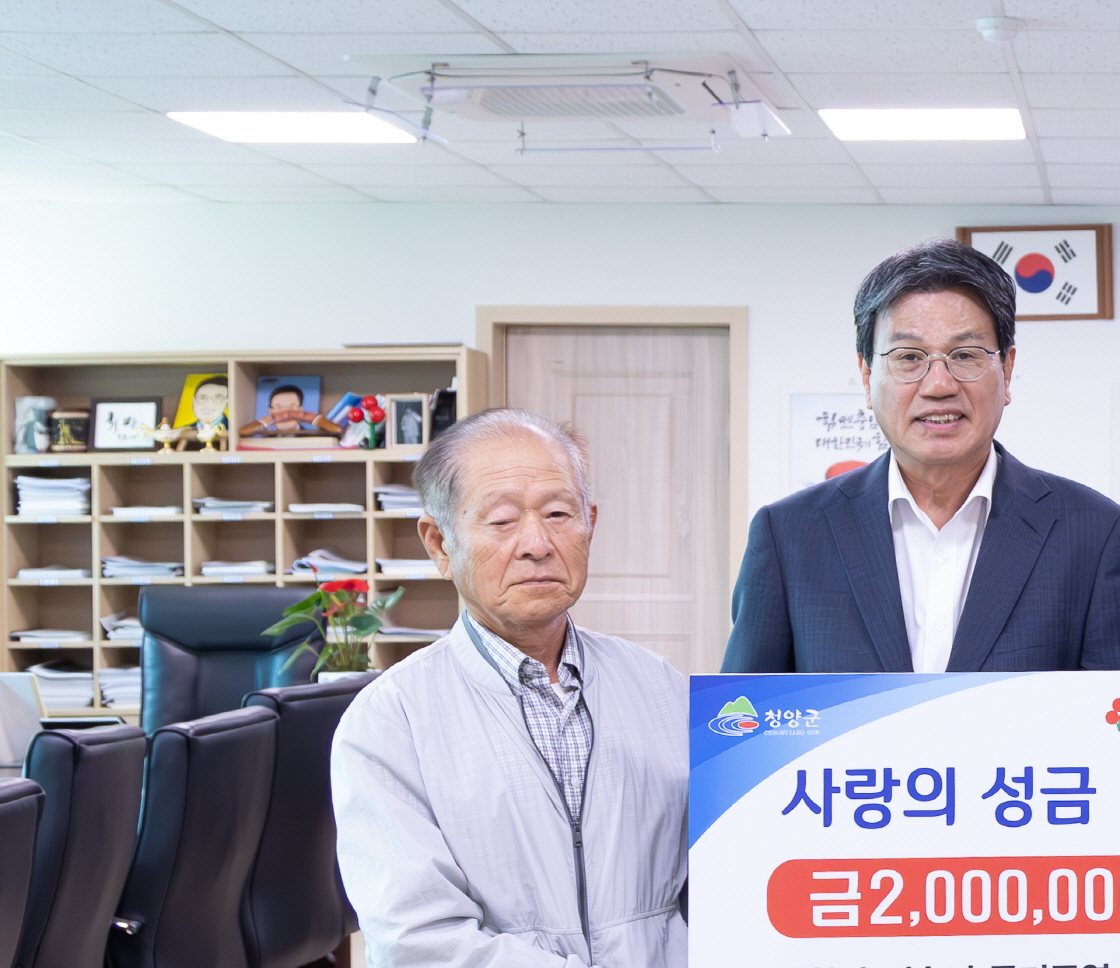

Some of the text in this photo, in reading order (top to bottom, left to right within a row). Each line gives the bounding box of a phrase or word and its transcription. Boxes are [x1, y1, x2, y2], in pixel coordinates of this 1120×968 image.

[764, 708, 822, 728] 청양군
[781, 766, 957, 830] 사랑의
[981, 766, 1097, 828] 성금
